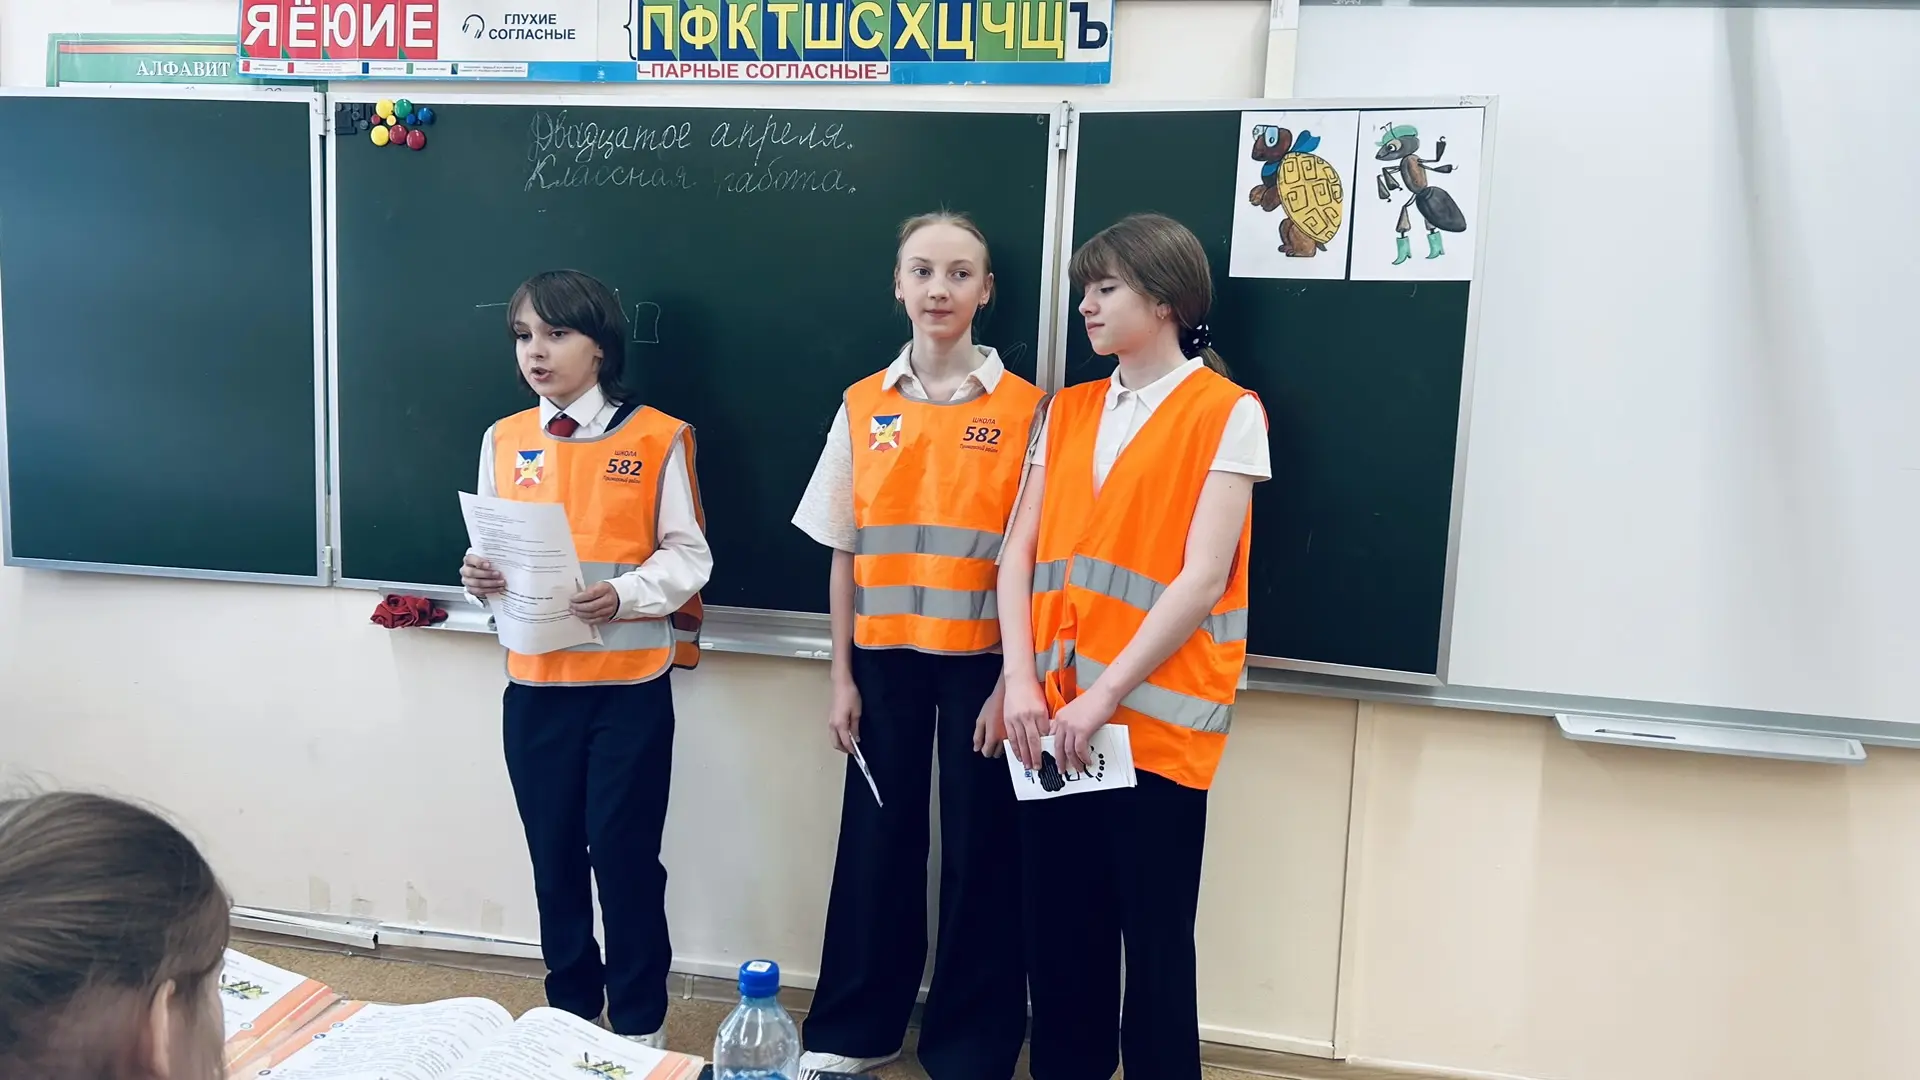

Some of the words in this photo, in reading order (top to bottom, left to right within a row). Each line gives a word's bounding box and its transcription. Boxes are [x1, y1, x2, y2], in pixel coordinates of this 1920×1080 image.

[504, 13, 557, 25] ГЛУХИЕ
[488, 28, 576, 40] СОГЛАСНЫЕ
[136, 61, 232, 78] АЛФАВИТ
[651, 63, 739, 79] ПАРНЫЕ
[745, 63, 878, 79] СОГЛАСНЫЕ
[962, 426, 1001, 445] 582
[606, 458, 642, 476] 582
